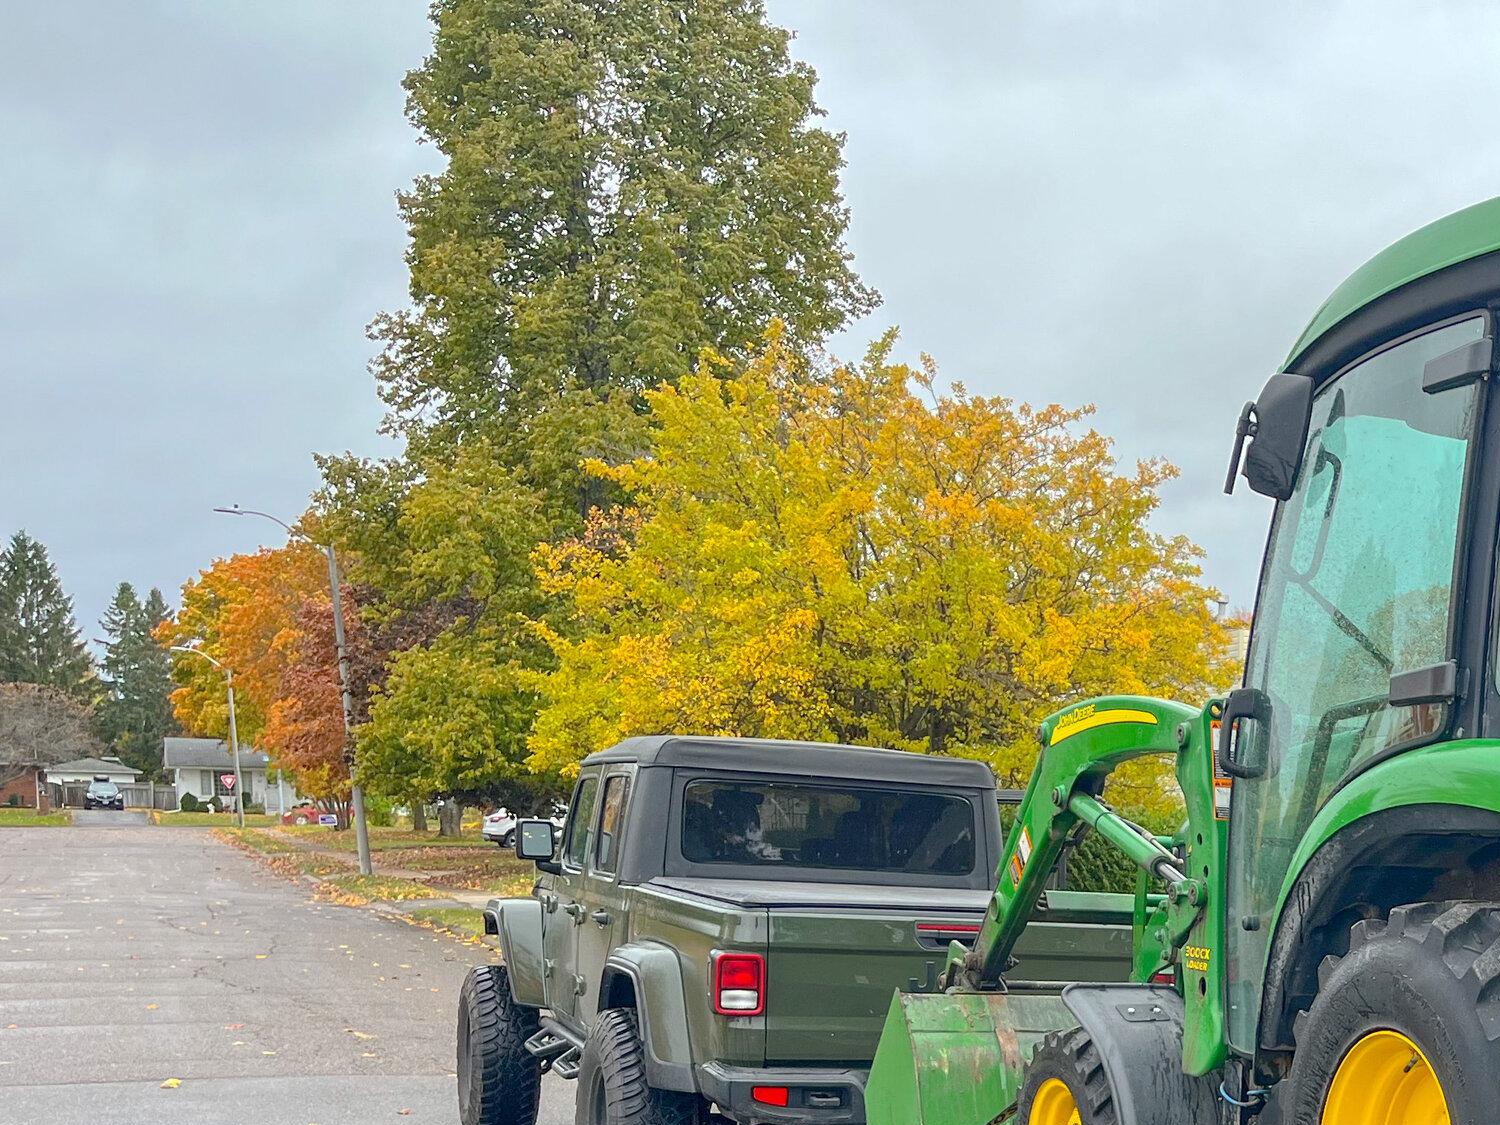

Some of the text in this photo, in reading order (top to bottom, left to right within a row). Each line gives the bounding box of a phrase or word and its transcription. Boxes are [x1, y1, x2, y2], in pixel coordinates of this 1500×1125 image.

[1057, 704, 1096, 729] JOHN DEERE
[1186, 959, 1208, 972] LOADER
